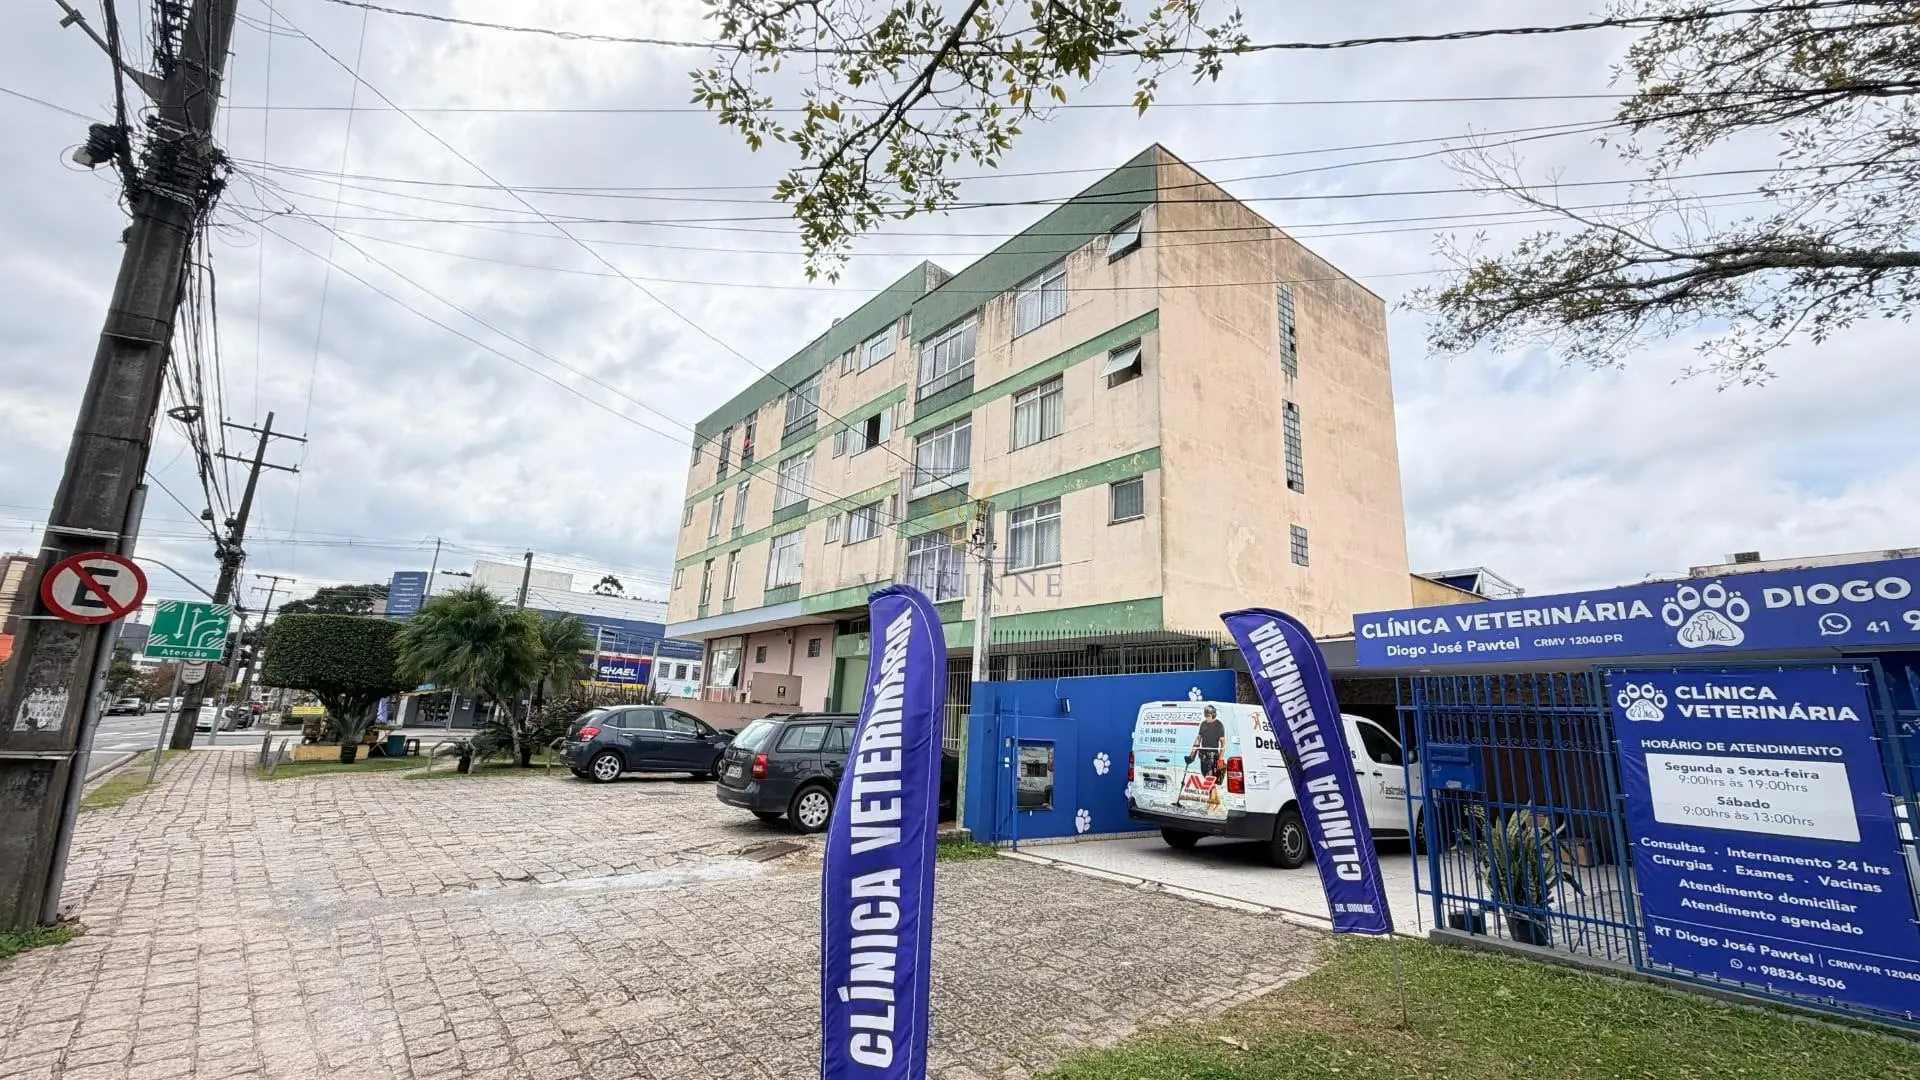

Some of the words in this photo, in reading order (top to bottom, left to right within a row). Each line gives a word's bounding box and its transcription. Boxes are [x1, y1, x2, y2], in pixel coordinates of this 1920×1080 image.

[71, 566, 119, 608] E
[1762, 576, 1912, 609] DIOGO
[1361, 617, 1451, 640] CLÍNICA
[1456, 599, 1653, 632] VETERINÁRIA
[1866, 620, 1891, 633] 41
[160, 648, 208, 658] Atenção
[1387, 643, 1427, 658] Diogo
[1430, 641, 1462, 654] José
[1468, 637, 1520, 652] Pawtel
[1533, 638, 1566, 647] CRMV
[1569, 636, 1602, 645] 12040
[1604, 634, 1623, 643] PR
[600, 666, 637, 677] SHAEL
[1248, 620, 1330, 770] VETERINÁRIA
[1675, 682, 1778, 700] CLÍNICA
[1143, 711, 1202, 721] ASTROTEK
[1677, 702, 1861, 722] VETERINÁRIA
[851, 605, 913, 856] VETERINÁRIA
[1641, 738, 1702, 751] HORÁRIO
[1706, 741, 1725, 752] DE
[1729, 742, 1843, 757] ATENDIMENTO
[1664, 761, 1722, 776] Segunda
[1726, 767, 1735, 775] a
[1738, 766, 1820, 780] Sexta-feira
[1678, 774, 1725, 787] 9:00hrs
[1729, 776, 1744, 788] às
[1748, 779, 1808, 793] 19:00hrs
[1716, 796, 1770, 810] Sábado
[1308, 774, 1363, 881] CLÍNICA
[1682, 806, 1731, 819] 9:00hrs
[1734, 809, 1749, 821] às
[1753, 812, 1815, 827] 13:00hrs
[1640, 837, 1706, 854] Consultas
[1726, 847, 1832, 870] Internamento
[1836, 860, 1858, 872] 24
[1863, 862, 1891, 876] hrs
[1653, 855, 1714, 873] Cirurgias
[1735, 865, 1795, 882] Exames
[1818, 875, 1882, 893] Vacinas
[1679, 879, 1774, 901] Atendimento
[1778, 892, 1858, 914] domiciliar
[1680, 898, 1776, 922] Atendimento
[1781, 914, 1864, 936] agendado
[1654, 925, 1672, 937] RT
[1675, 929, 1718, 947] Diogo
[1722, 938, 1756, 954] José
[1759, 945, 1815, 965] Pawtel
[1827, 958, 1881, 975] CRMV-PR
[1884, 968, 1920, 982] 12040
[837, 868, 901, 1069] CLÍNICA
[1759, 965, 1847, 991] 98836-8506
